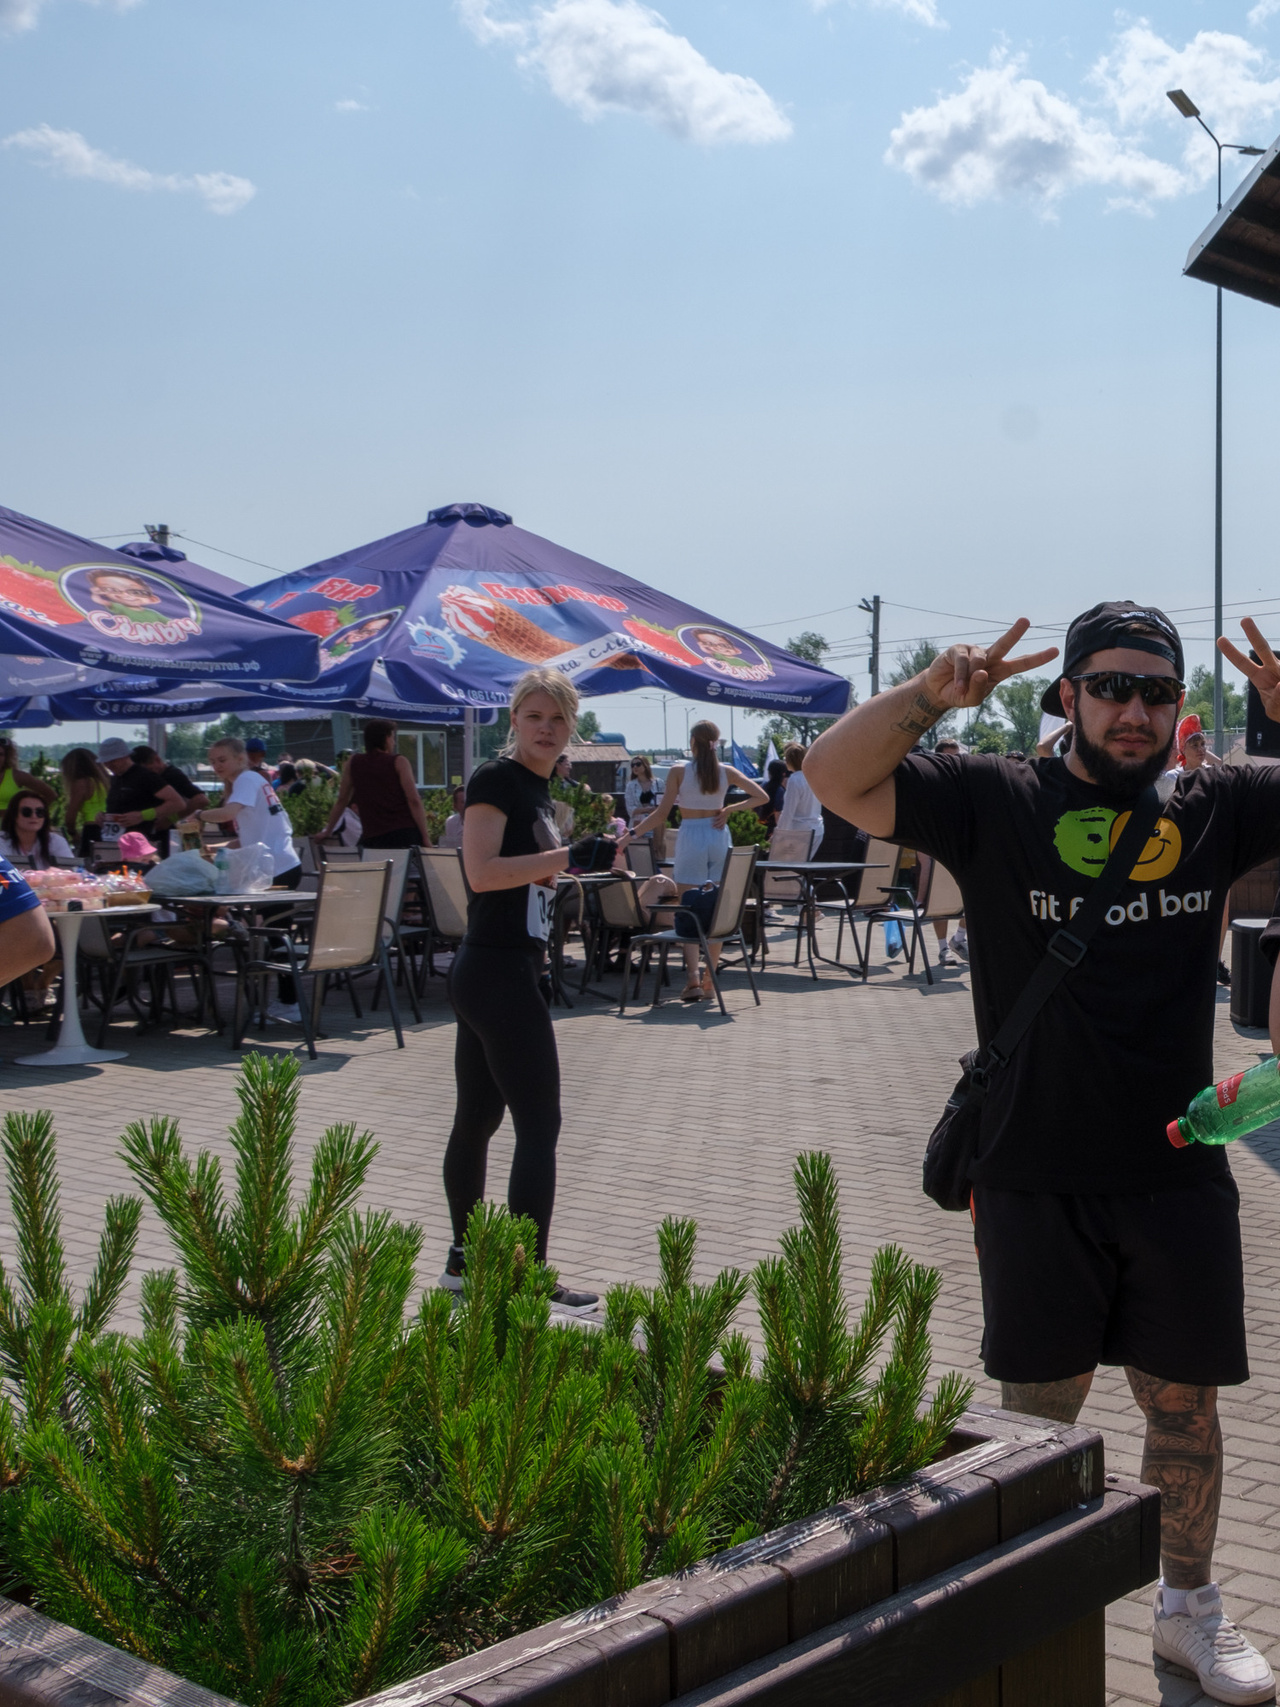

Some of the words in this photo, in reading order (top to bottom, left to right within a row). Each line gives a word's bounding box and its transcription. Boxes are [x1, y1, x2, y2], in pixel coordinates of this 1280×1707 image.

[557, 659, 581, 675] на
[457, 688, 466, 698] 8
[467, 689, 508, 703] (86147)
[1029, 890, 1062, 922] fit
[1069, 892, 1149, 926] fod
[1159, 889, 1212, 917] bar
